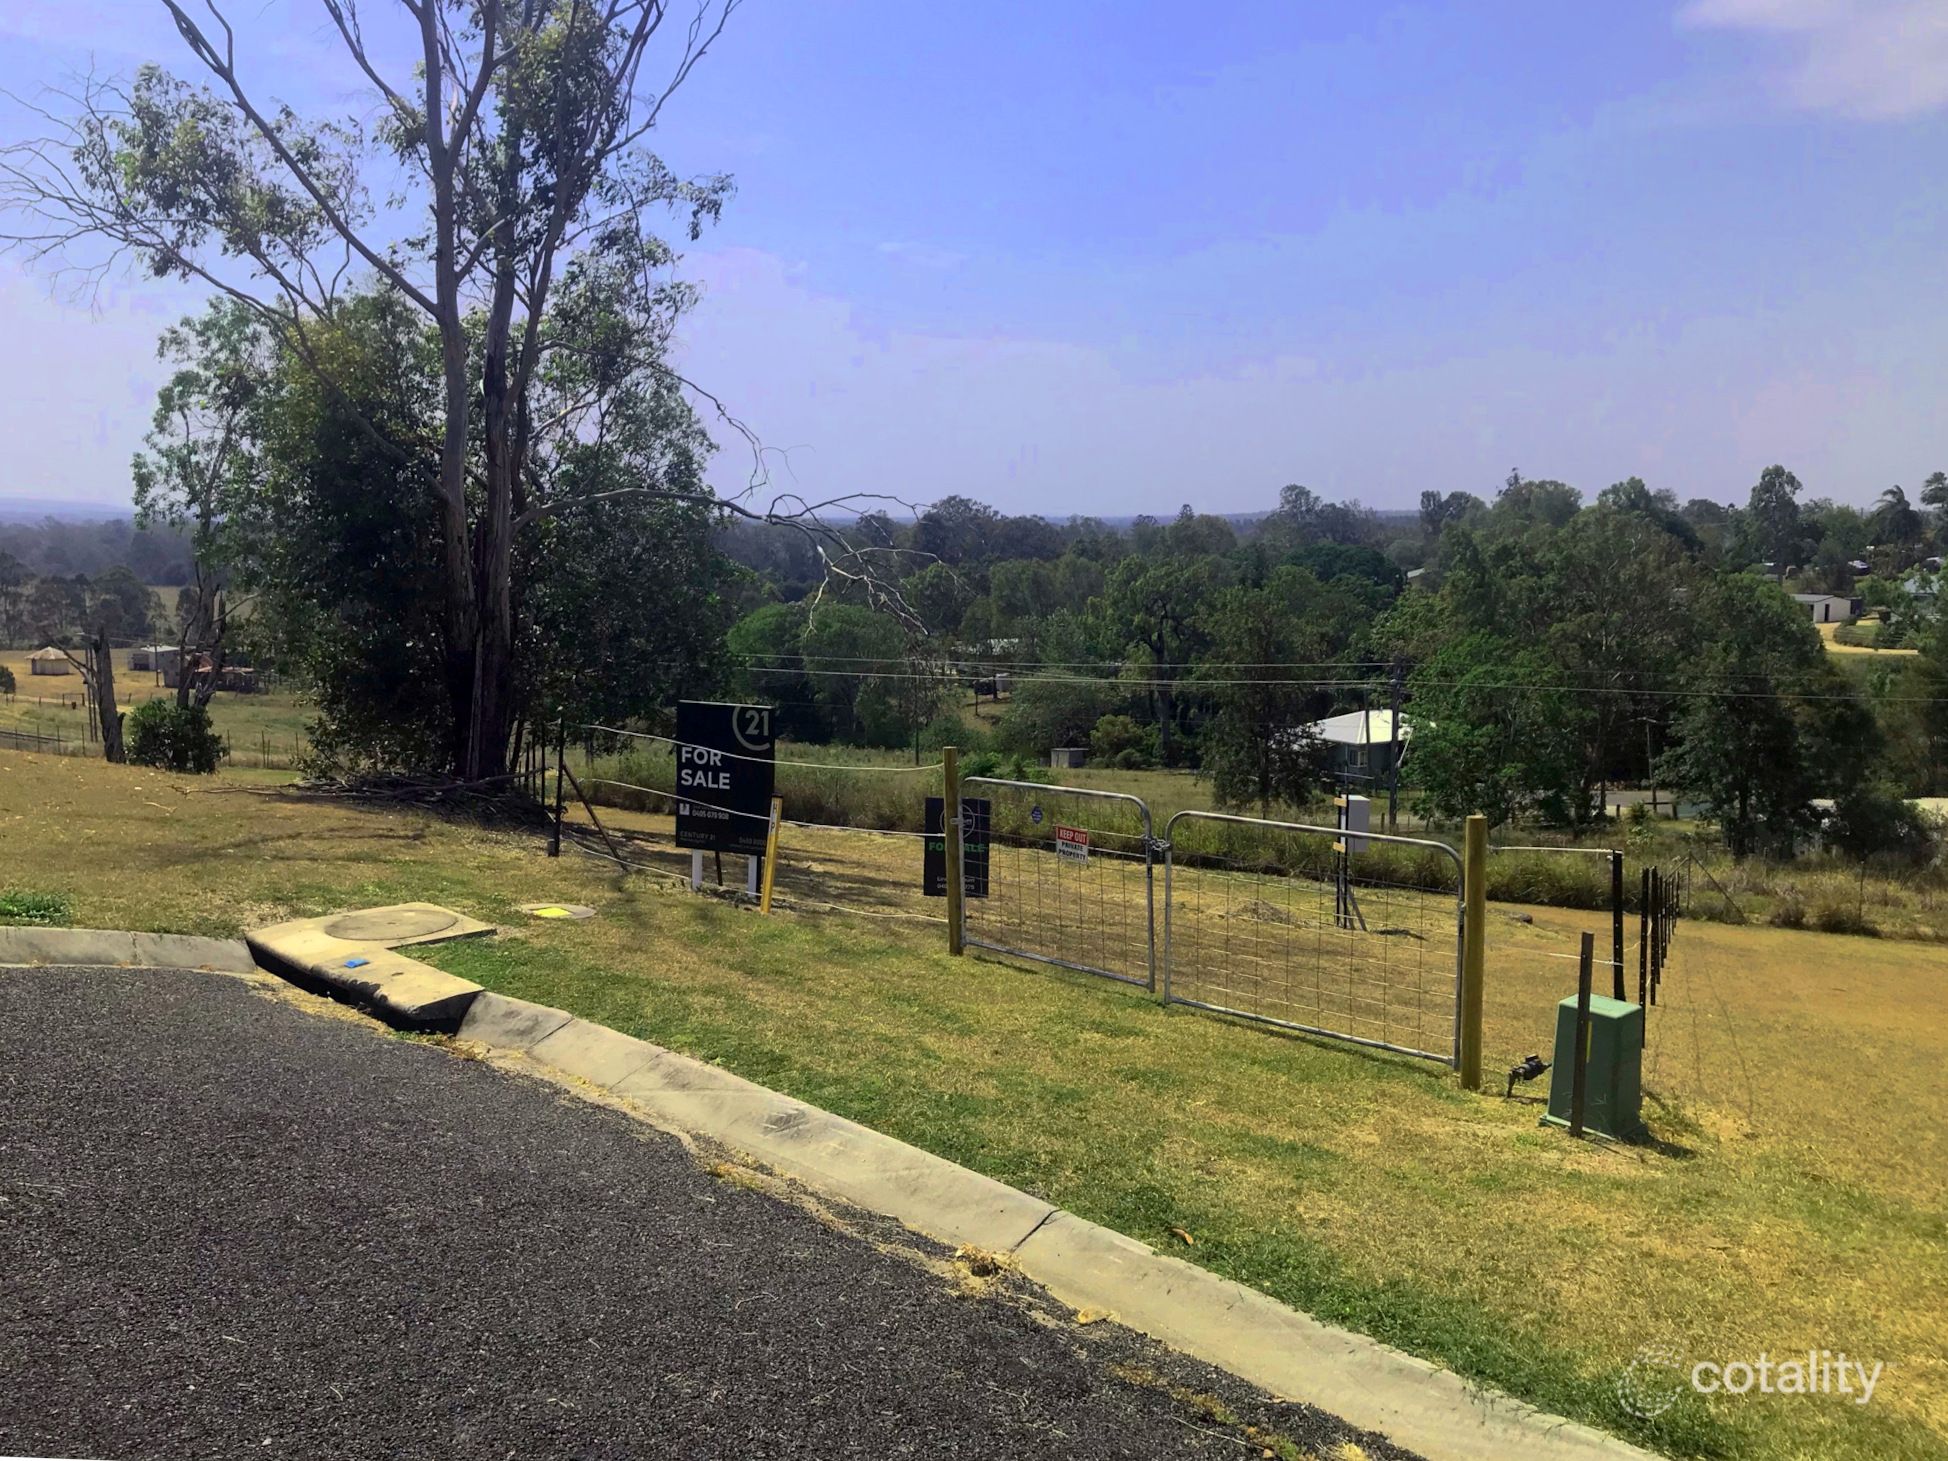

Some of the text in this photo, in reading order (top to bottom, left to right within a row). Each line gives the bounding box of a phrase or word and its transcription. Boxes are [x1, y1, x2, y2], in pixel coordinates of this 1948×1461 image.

[681, 746, 722, 766] FOR
[681, 769, 730, 789] SALE
[1059, 829, 1087, 843] KEEP OUT
[929, 842, 985, 853] FO ALE
[1058, 848, 1086, 861] PROPERTY
